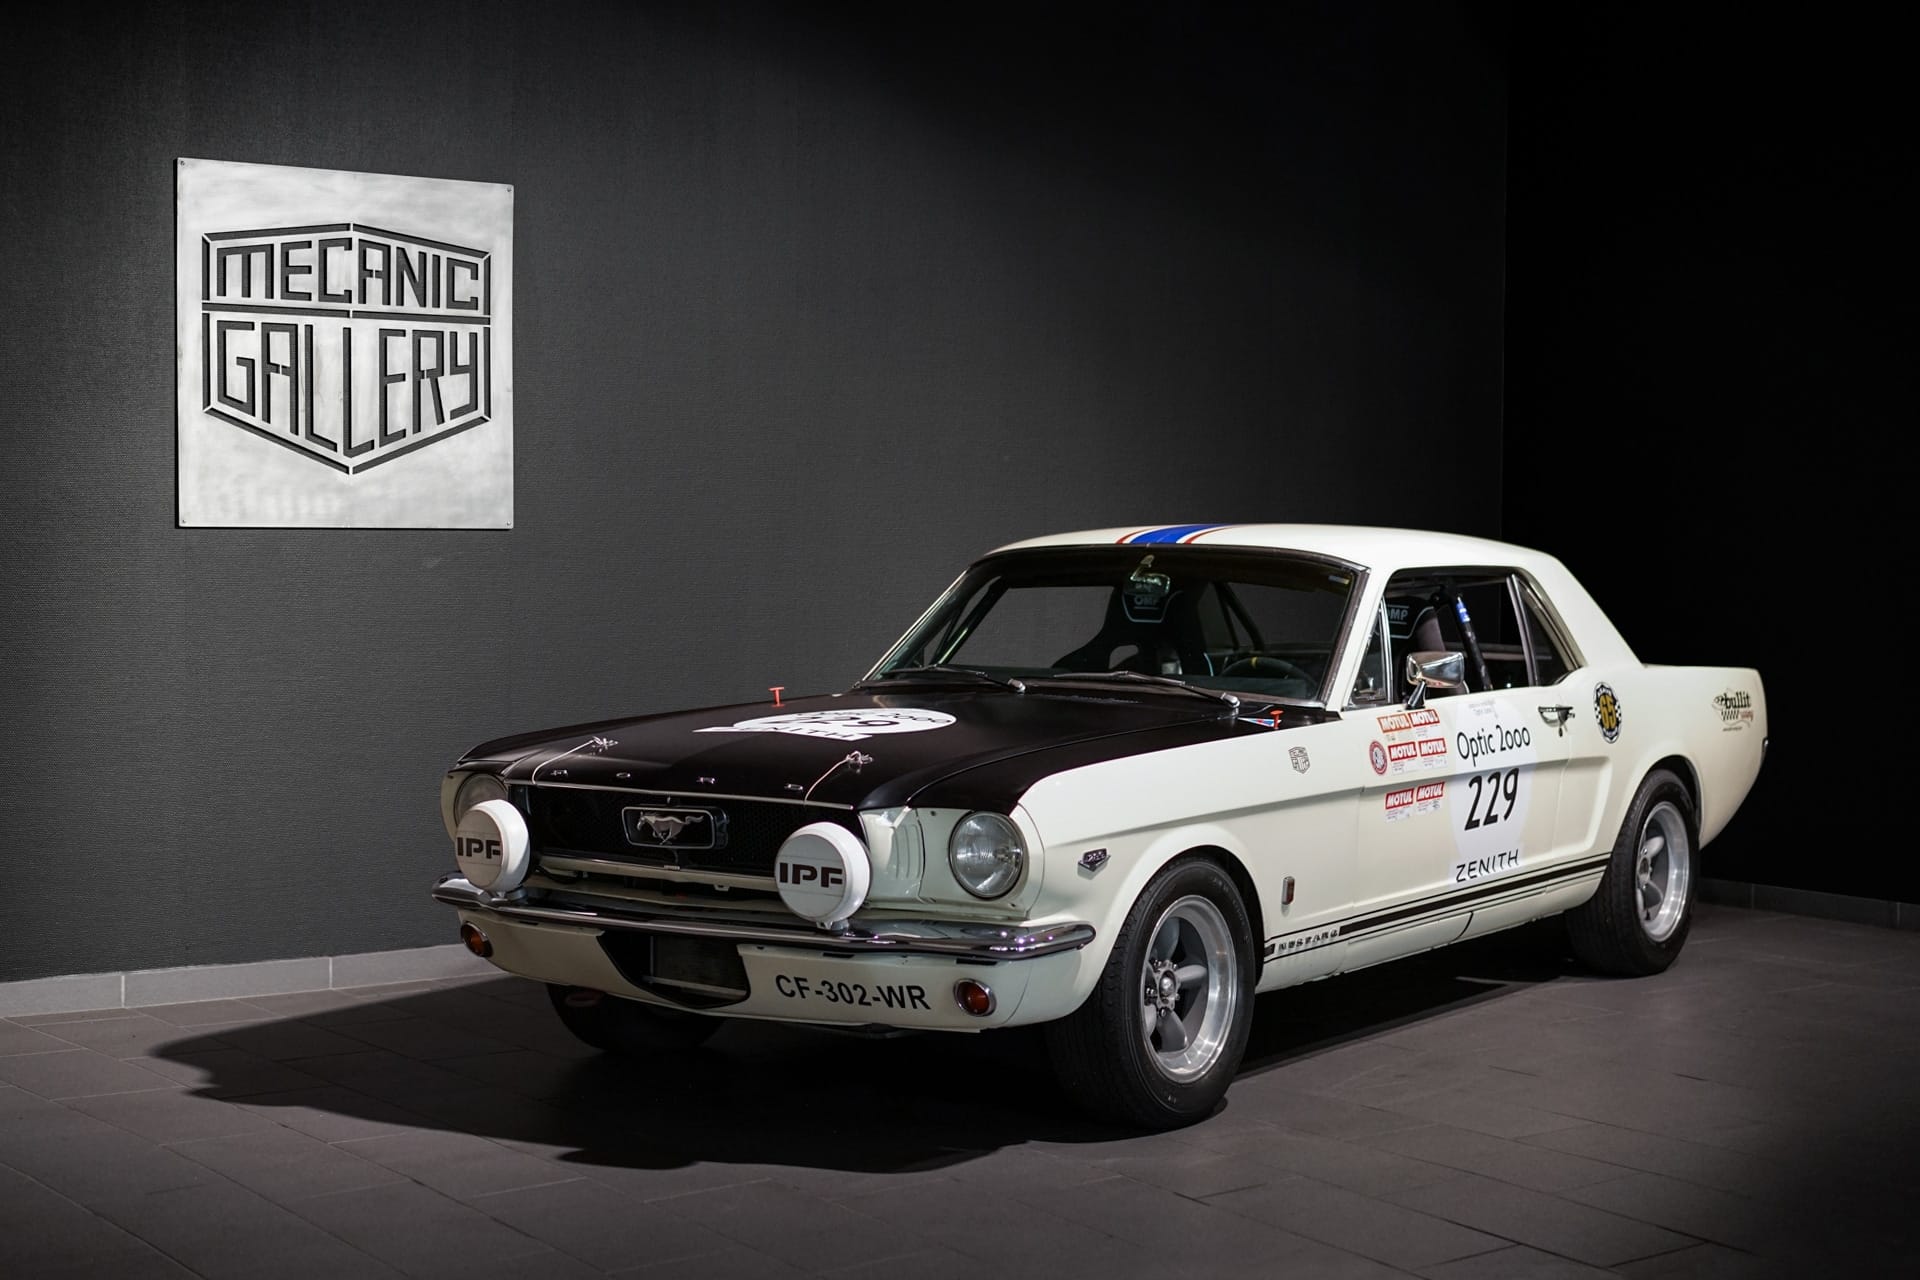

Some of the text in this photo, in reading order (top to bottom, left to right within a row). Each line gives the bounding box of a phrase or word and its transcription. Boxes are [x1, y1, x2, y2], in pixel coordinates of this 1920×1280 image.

[217, 236, 479, 311] MECANIC
[217, 320, 479, 458] GALLERY
[1380, 715, 1410, 731] MOTUL
[1410, 711, 1439, 726] MOTUL
[1390, 743, 1418, 760] MOTUL
[1421, 740, 1446, 756] MOTUL
[1456, 724, 1532, 767] Optic 2000
[1386, 790, 1413, 807] MOTUL
[1417, 785, 1444, 801] MOTUL
[1464, 767, 1520, 832] 229
[457, 836, 502, 857] IPF
[779, 862, 843, 888] IPF
[1456, 848, 1520, 883] ZENITH
[775, 974, 932, 1011] CF-302-WR
